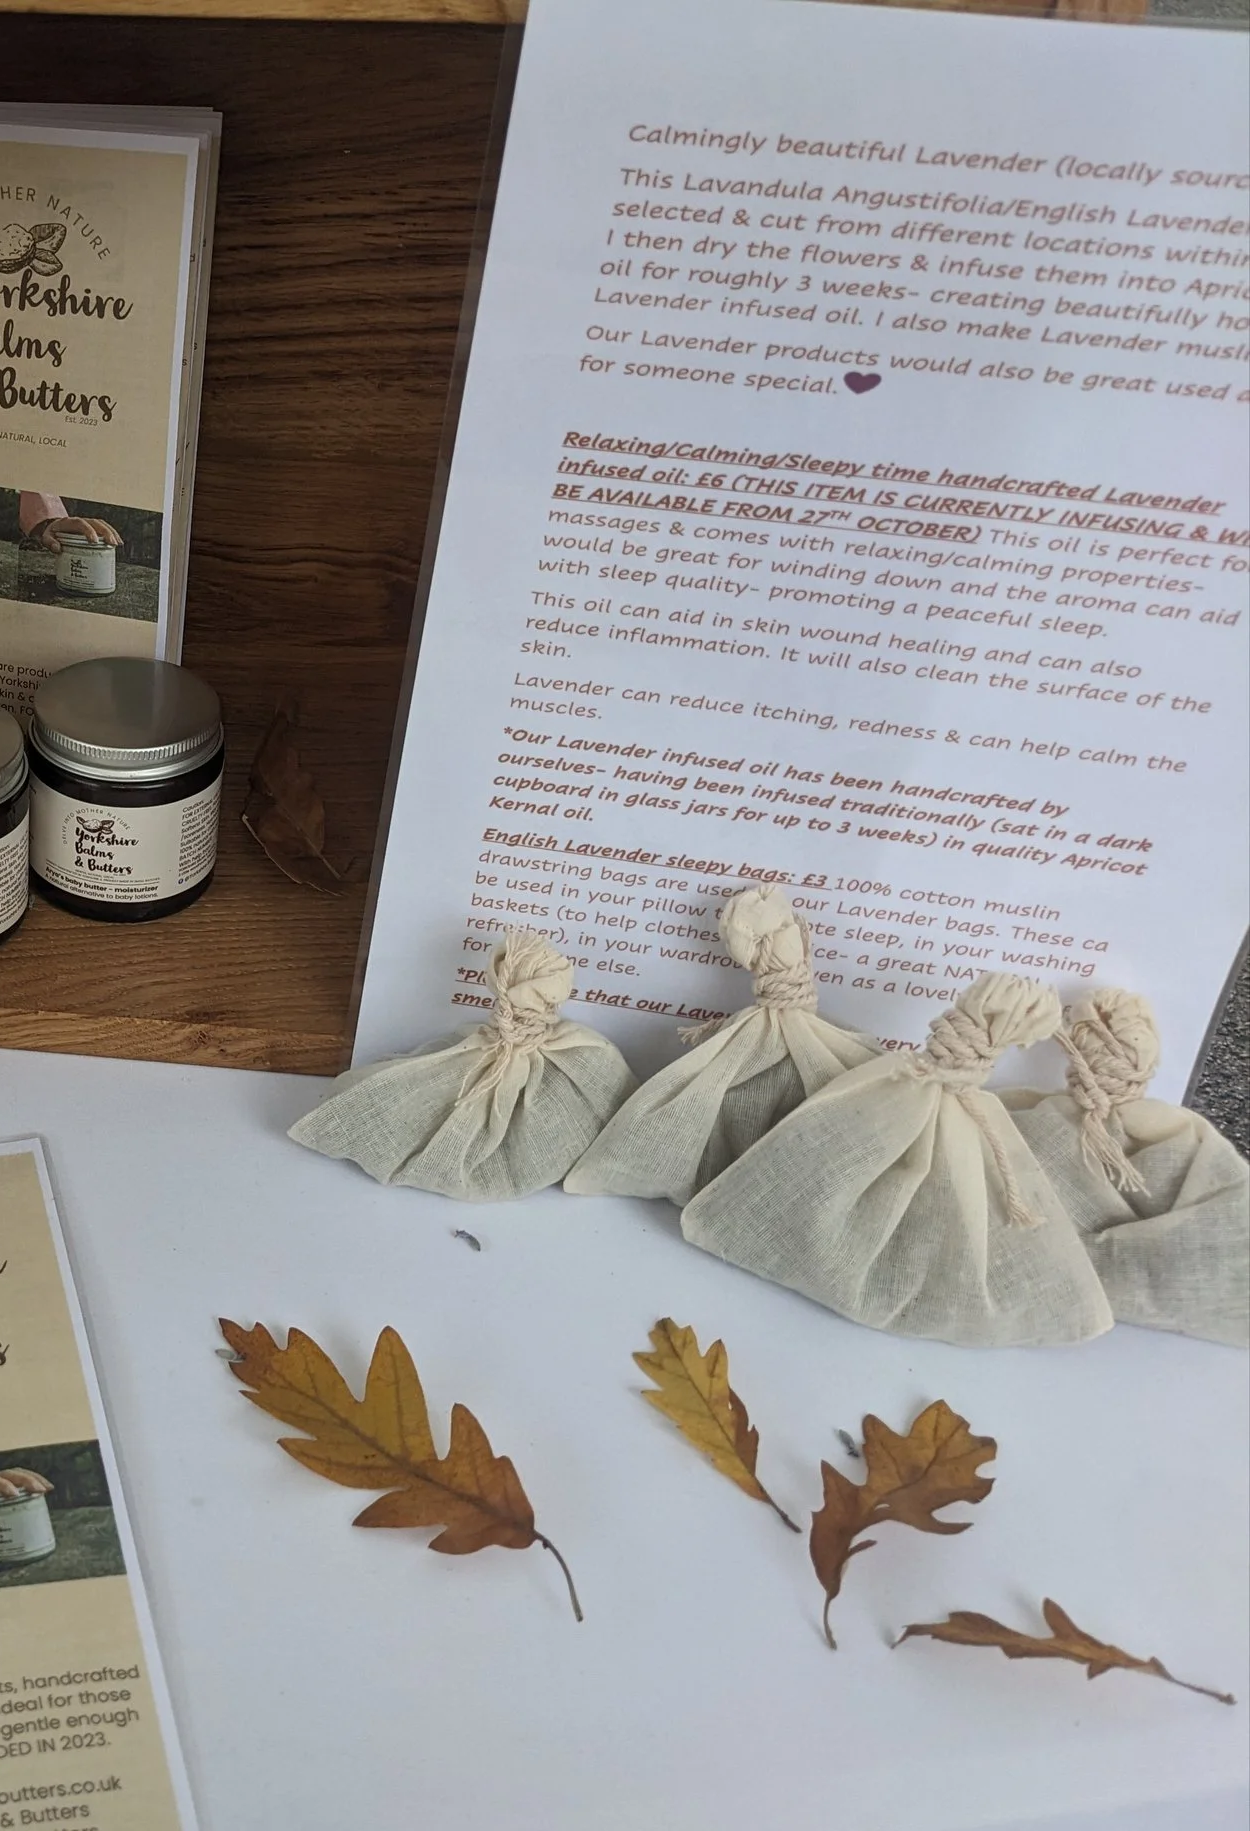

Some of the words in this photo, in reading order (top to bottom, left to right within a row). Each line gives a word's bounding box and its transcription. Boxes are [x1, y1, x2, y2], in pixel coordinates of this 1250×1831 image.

[628, 124, 768, 156] Calmingly
[776, 133, 906, 163] beautiful
[915, 146, 1048, 172] Lavender
[1055, 155, 1163, 187] (locally
[46, 194, 110, 260] NATURE
[580, 354, 616, 373] for
[623, 363, 735, 385] someone
[743, 374, 837, 394] special.
[586, 325, 633, 343] Our
[640, 330, 758, 354] Lavender
[764, 343, 880, 366] products
[890, 355, 973, 376] would
[978, 361, 1034, 381] also
[1043, 366, 1075, 385] be
[1081, 374, 1157, 393] great
[1165, 382, 1232, 401] used
[38, 436, 67, 448] LOCAL
[562, 432, 866, 478] Relaxing/Calming/Sleepy
[871, 462, 931, 484] time
[938, 468, 1101, 501] handcrafted
[1104, 488, 1226, 516] Lavender
[552, 484, 582, 500] BE
[587, 488, 717, 514] AVAILABLE
[722, 502, 793, 522] FROM
[798, 510, 852, 526] 27TH
[856, 516, 982, 544] OCTOBER)
[990, 529, 1039, 548] This
[1048, 537, 1081, 553] oil
[1089, 540, 1110, 556] is
[1117, 546, 1214, 568] perfect
[18, 692, 25, 700] &
[556, 735, 657, 759] Lavender
[662, 748, 746, 772] infused
[749, 761, 780, 776] oil
[782, 765, 825, 783] has
[830, 771, 883, 792] been
[890, 780, 1037, 813] handcrafted
[1039, 800, 1070, 819] by
[75, 827, 139, 846] Yorkshire
[75, 842, 114, 860] Balms
[74, 856, 84, 868] &
[88, 858, 133, 874] Butters
[481, 828, 558, 852] English
[556, 839, 662, 867] Lavender
[661, 854, 733, 877] sleepy
[732, 862, 797, 886] bags:
[801, 873, 829, 887] £3
[828, 877, 892, 896] 100%
[899, 889, 975, 908] cotton
[984, 900, 1060, 921] muslin
[66, 876, 82, 887] baby
[84, 882, 106, 891] butter
[22, 1664, 141, 1691] handcrafted
[36, 1738, 56, 1753] IN
[60, 1731, 112, 1751] 2023.
